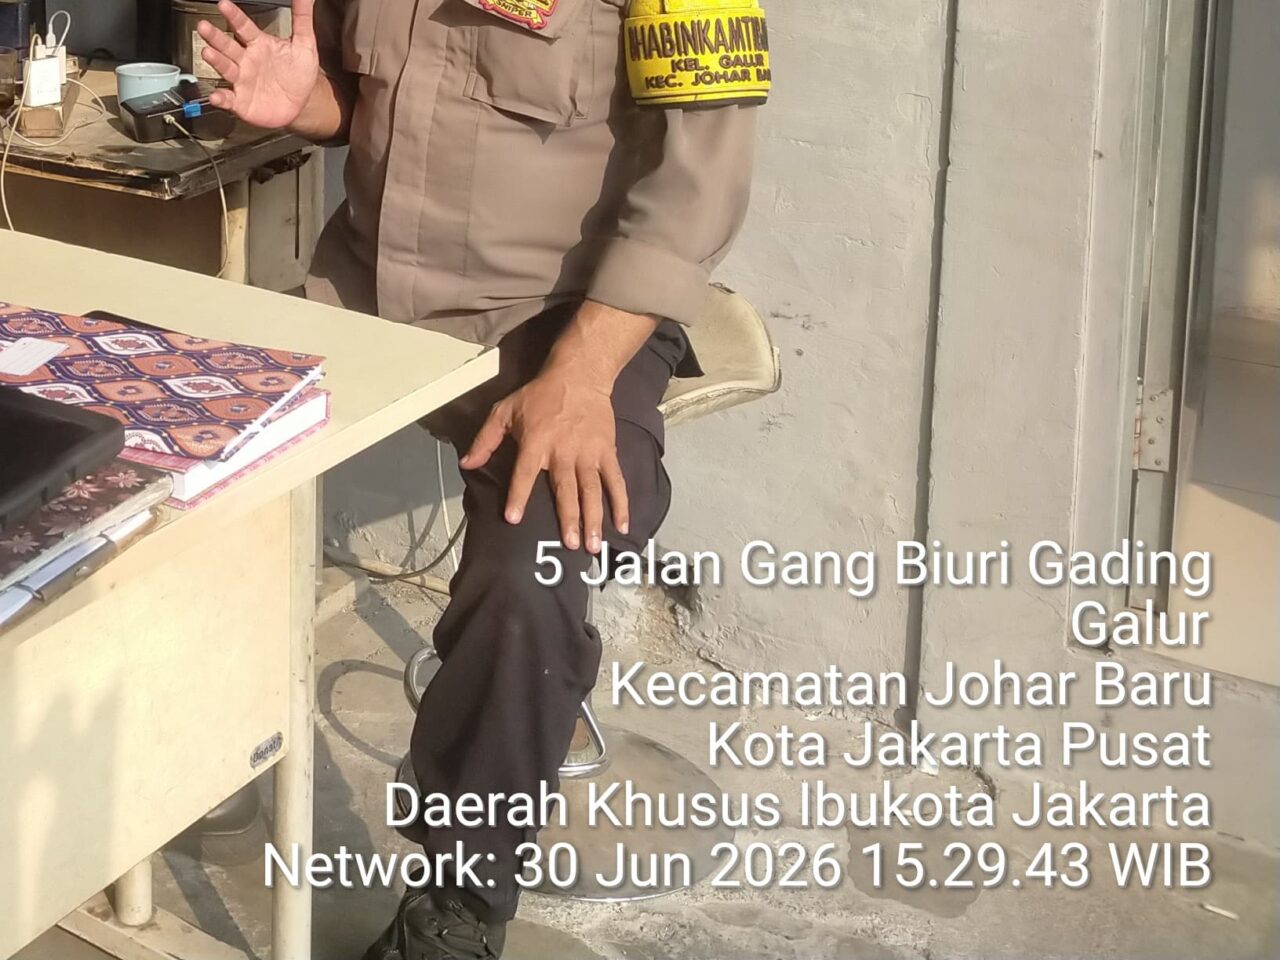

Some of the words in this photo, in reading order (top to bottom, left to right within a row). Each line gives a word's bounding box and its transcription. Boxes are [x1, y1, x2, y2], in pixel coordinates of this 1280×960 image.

[671, 57, 710, 73] KEL.
[644, 73, 683, 89] KEC.
[691, 68, 751, 86] JOHAR
